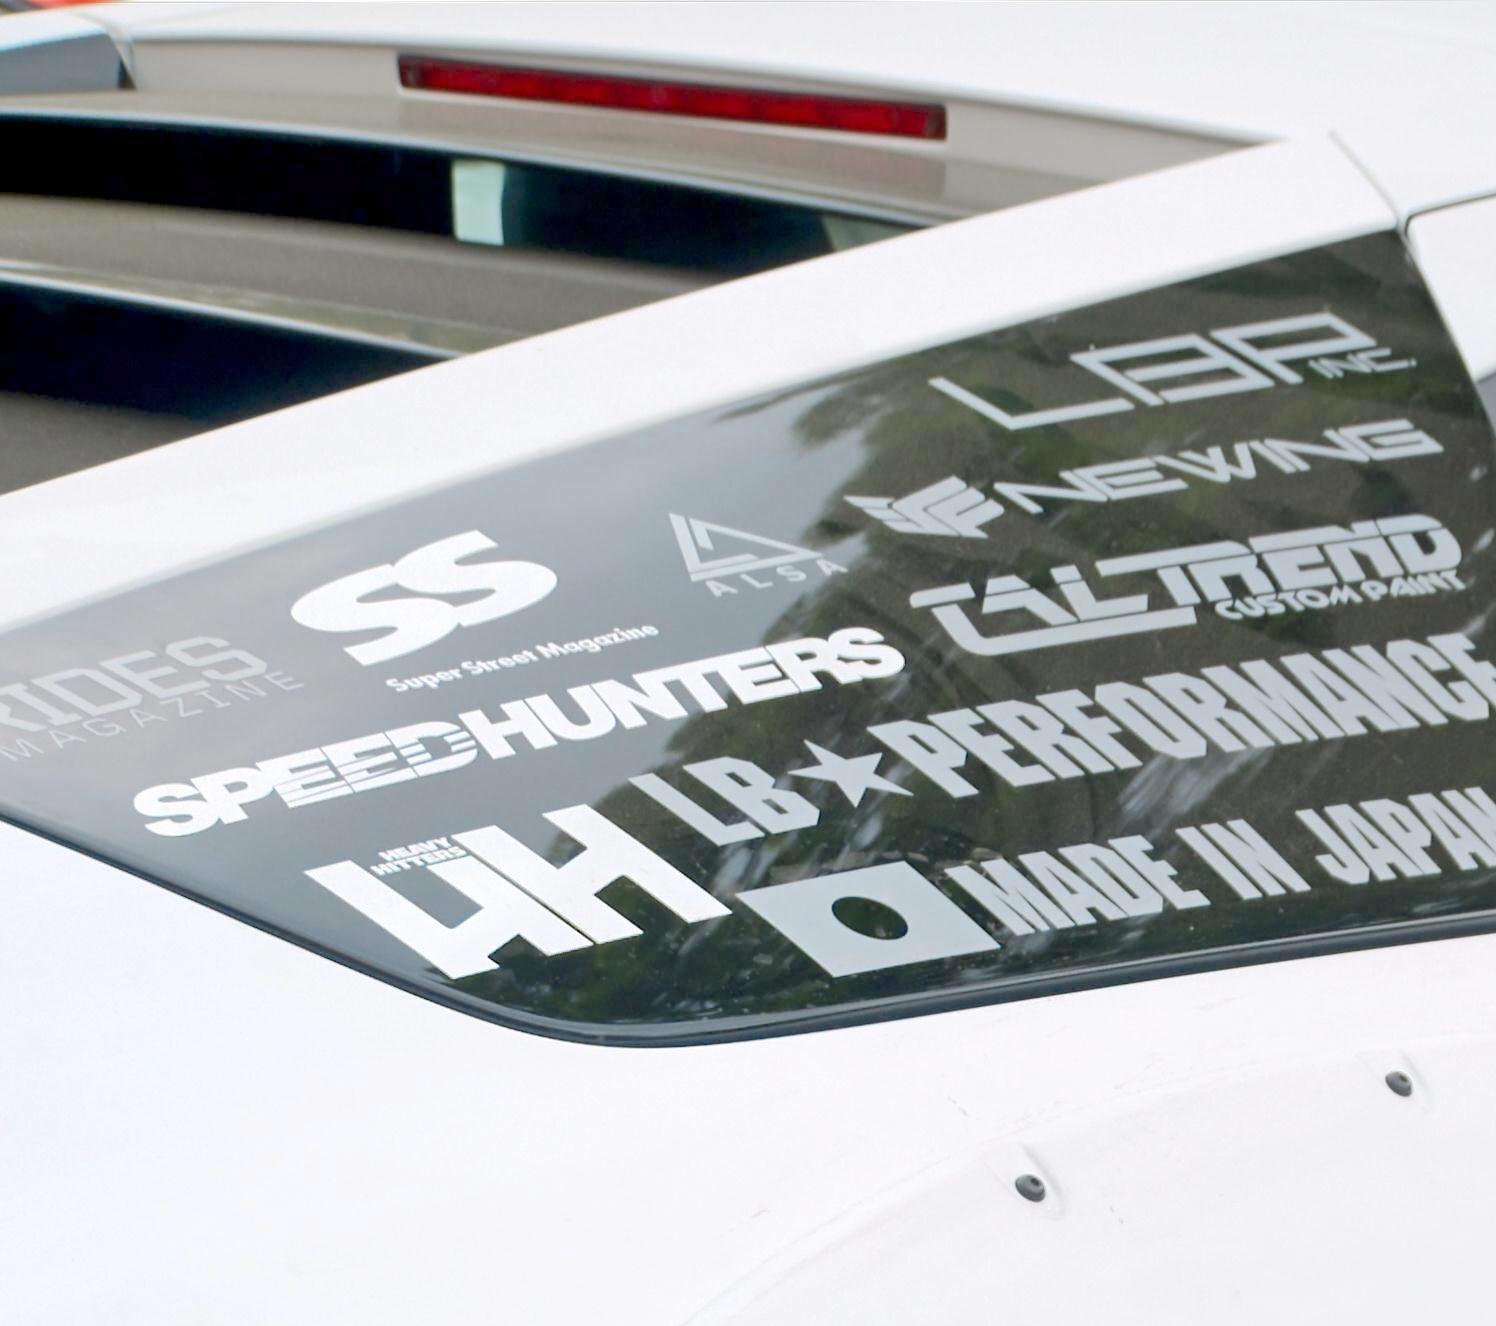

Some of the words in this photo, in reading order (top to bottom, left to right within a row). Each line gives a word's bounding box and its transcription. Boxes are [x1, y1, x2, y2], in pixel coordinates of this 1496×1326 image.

[994, 418, 1443, 515] NEWING
[291, 530, 557, 666] SS
[705, 557, 849, 598] ALSA
[1214, 584, 1364, 620] CUSTOM
[1367, 568, 1467, 603] PAINT
[386, 665, 463, 692] Super
[461, 650, 539, 676] Street
[536, 625, 660, 654] Magazine
[133, 626, 906, 836] SPEEDHUNTERS
[370, 846, 468, 876] HITTERS
[378, 837, 452, 861] HEAVY
[942, 834, 1210, 938] MADE
[1176, 819, 1311, 901] IN
